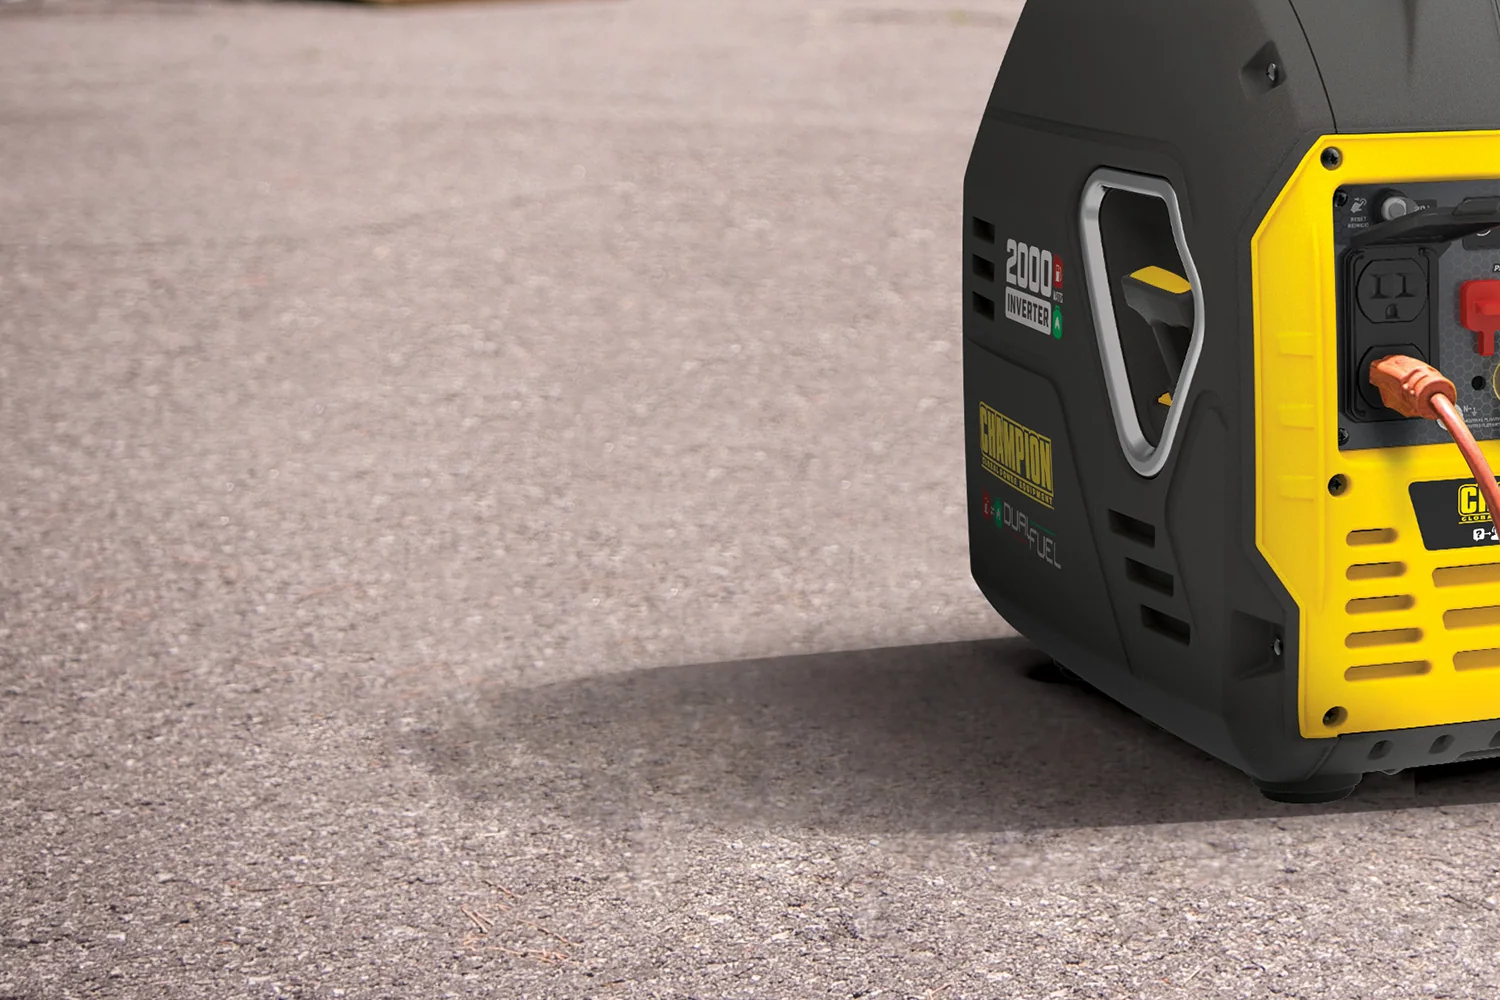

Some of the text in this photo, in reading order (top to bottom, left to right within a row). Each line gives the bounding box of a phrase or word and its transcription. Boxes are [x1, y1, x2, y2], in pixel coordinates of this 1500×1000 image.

[1006, 238, 1052, 298] 2000
[1007, 293, 1049, 328] INVERTER
[980, 405, 1052, 492] CHAMPION
